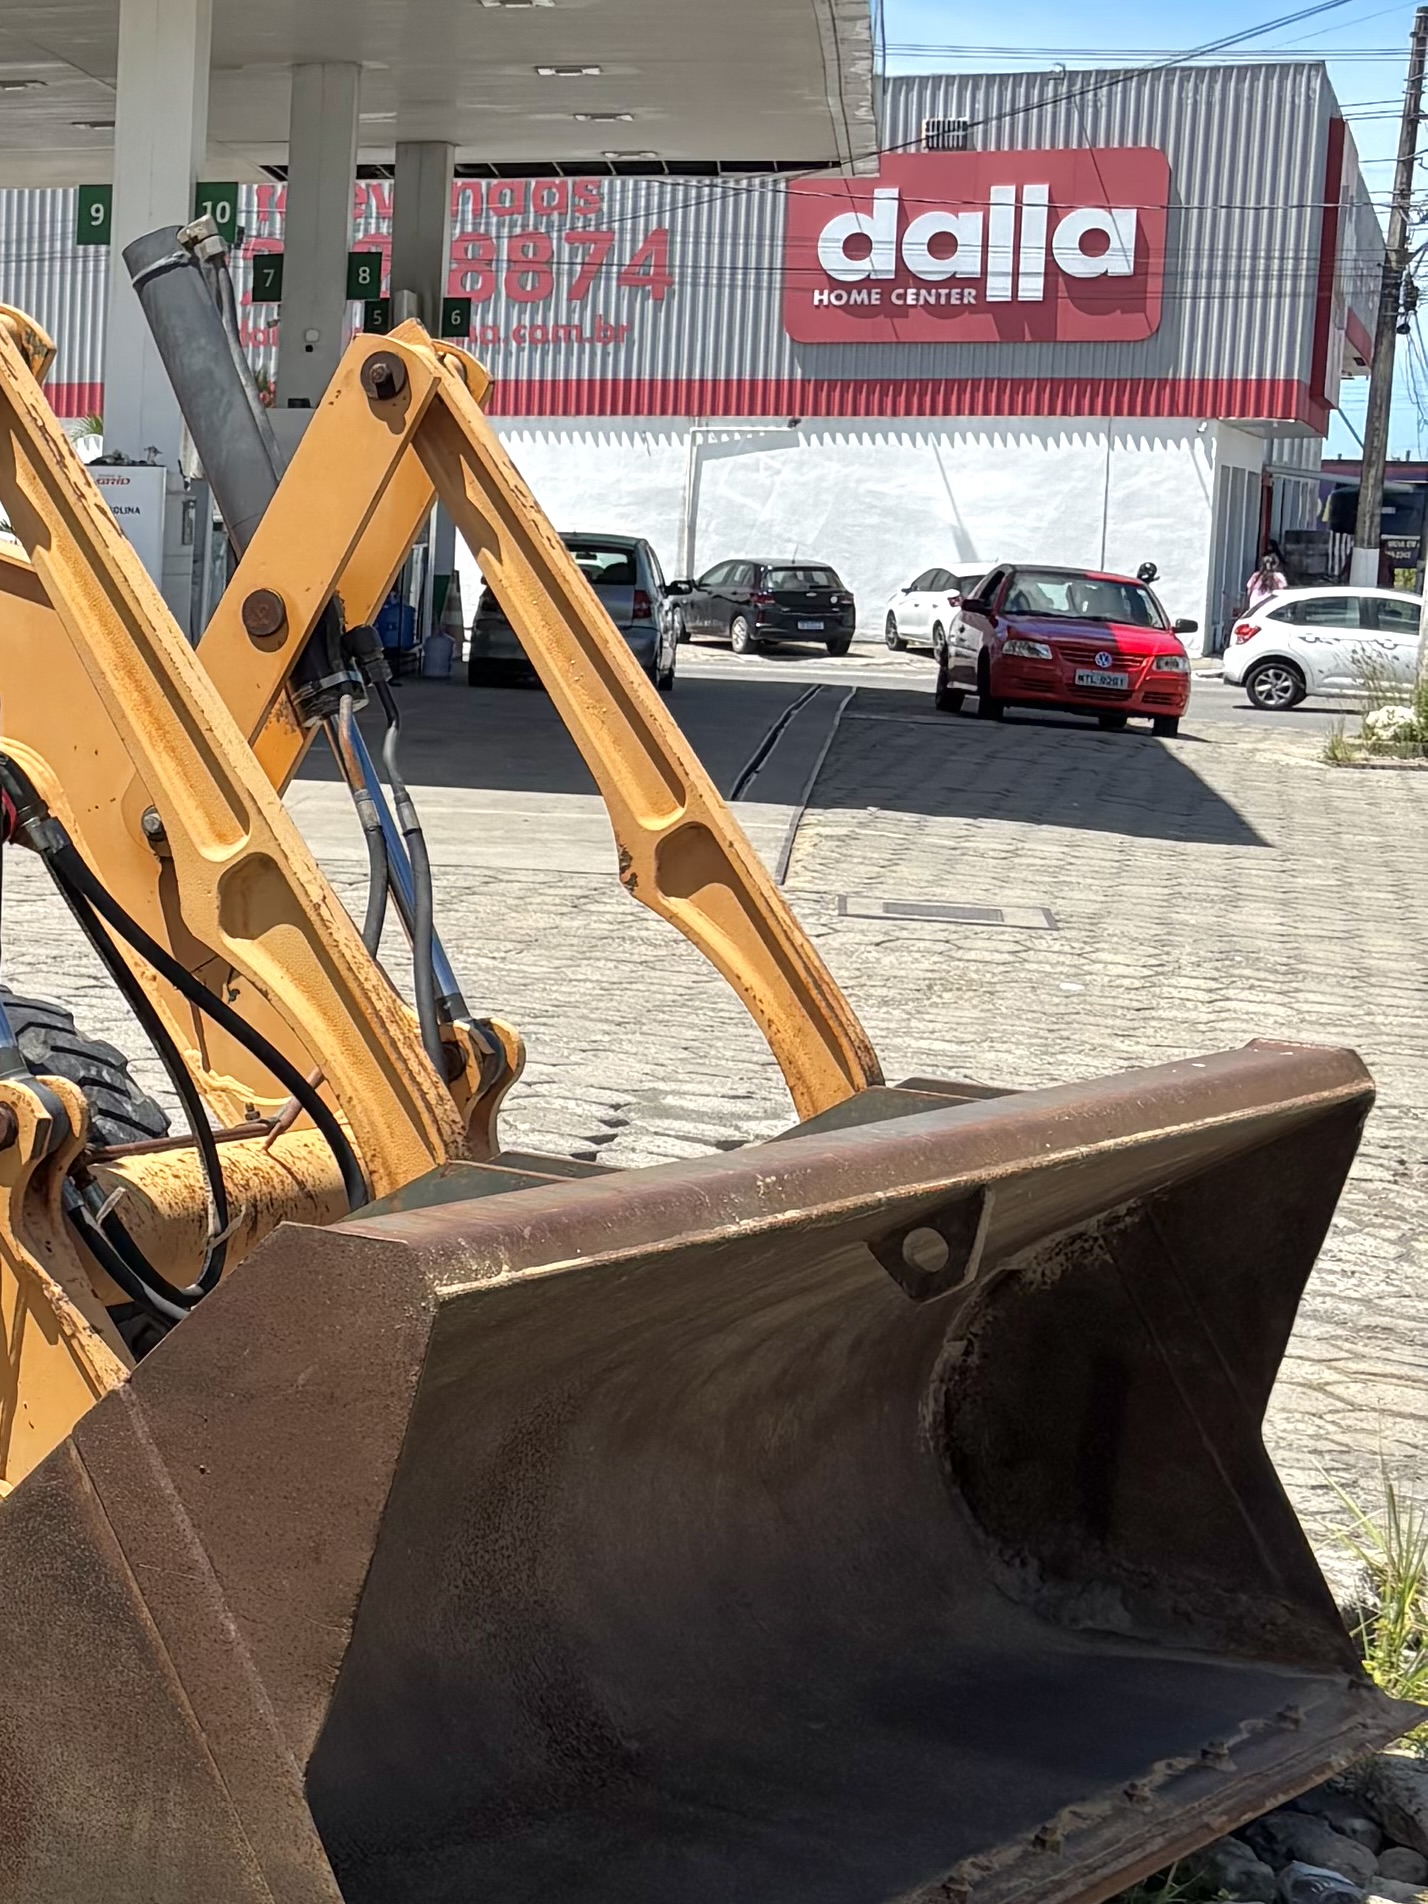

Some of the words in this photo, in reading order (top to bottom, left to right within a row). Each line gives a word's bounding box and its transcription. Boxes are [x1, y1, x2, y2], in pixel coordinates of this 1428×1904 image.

[90, 203, 105, 226] 9
[202, 201, 231, 224] 10
[817, 183, 1138, 302] dalla
[262, 268, 276, 287] 7
[357, 266, 371, 285] 8
[813, 288, 881, 306] HOME
[891, 287, 977, 305] CENTER
[373, 310, 383, 325] 5
[451, 309, 462, 325] 6
